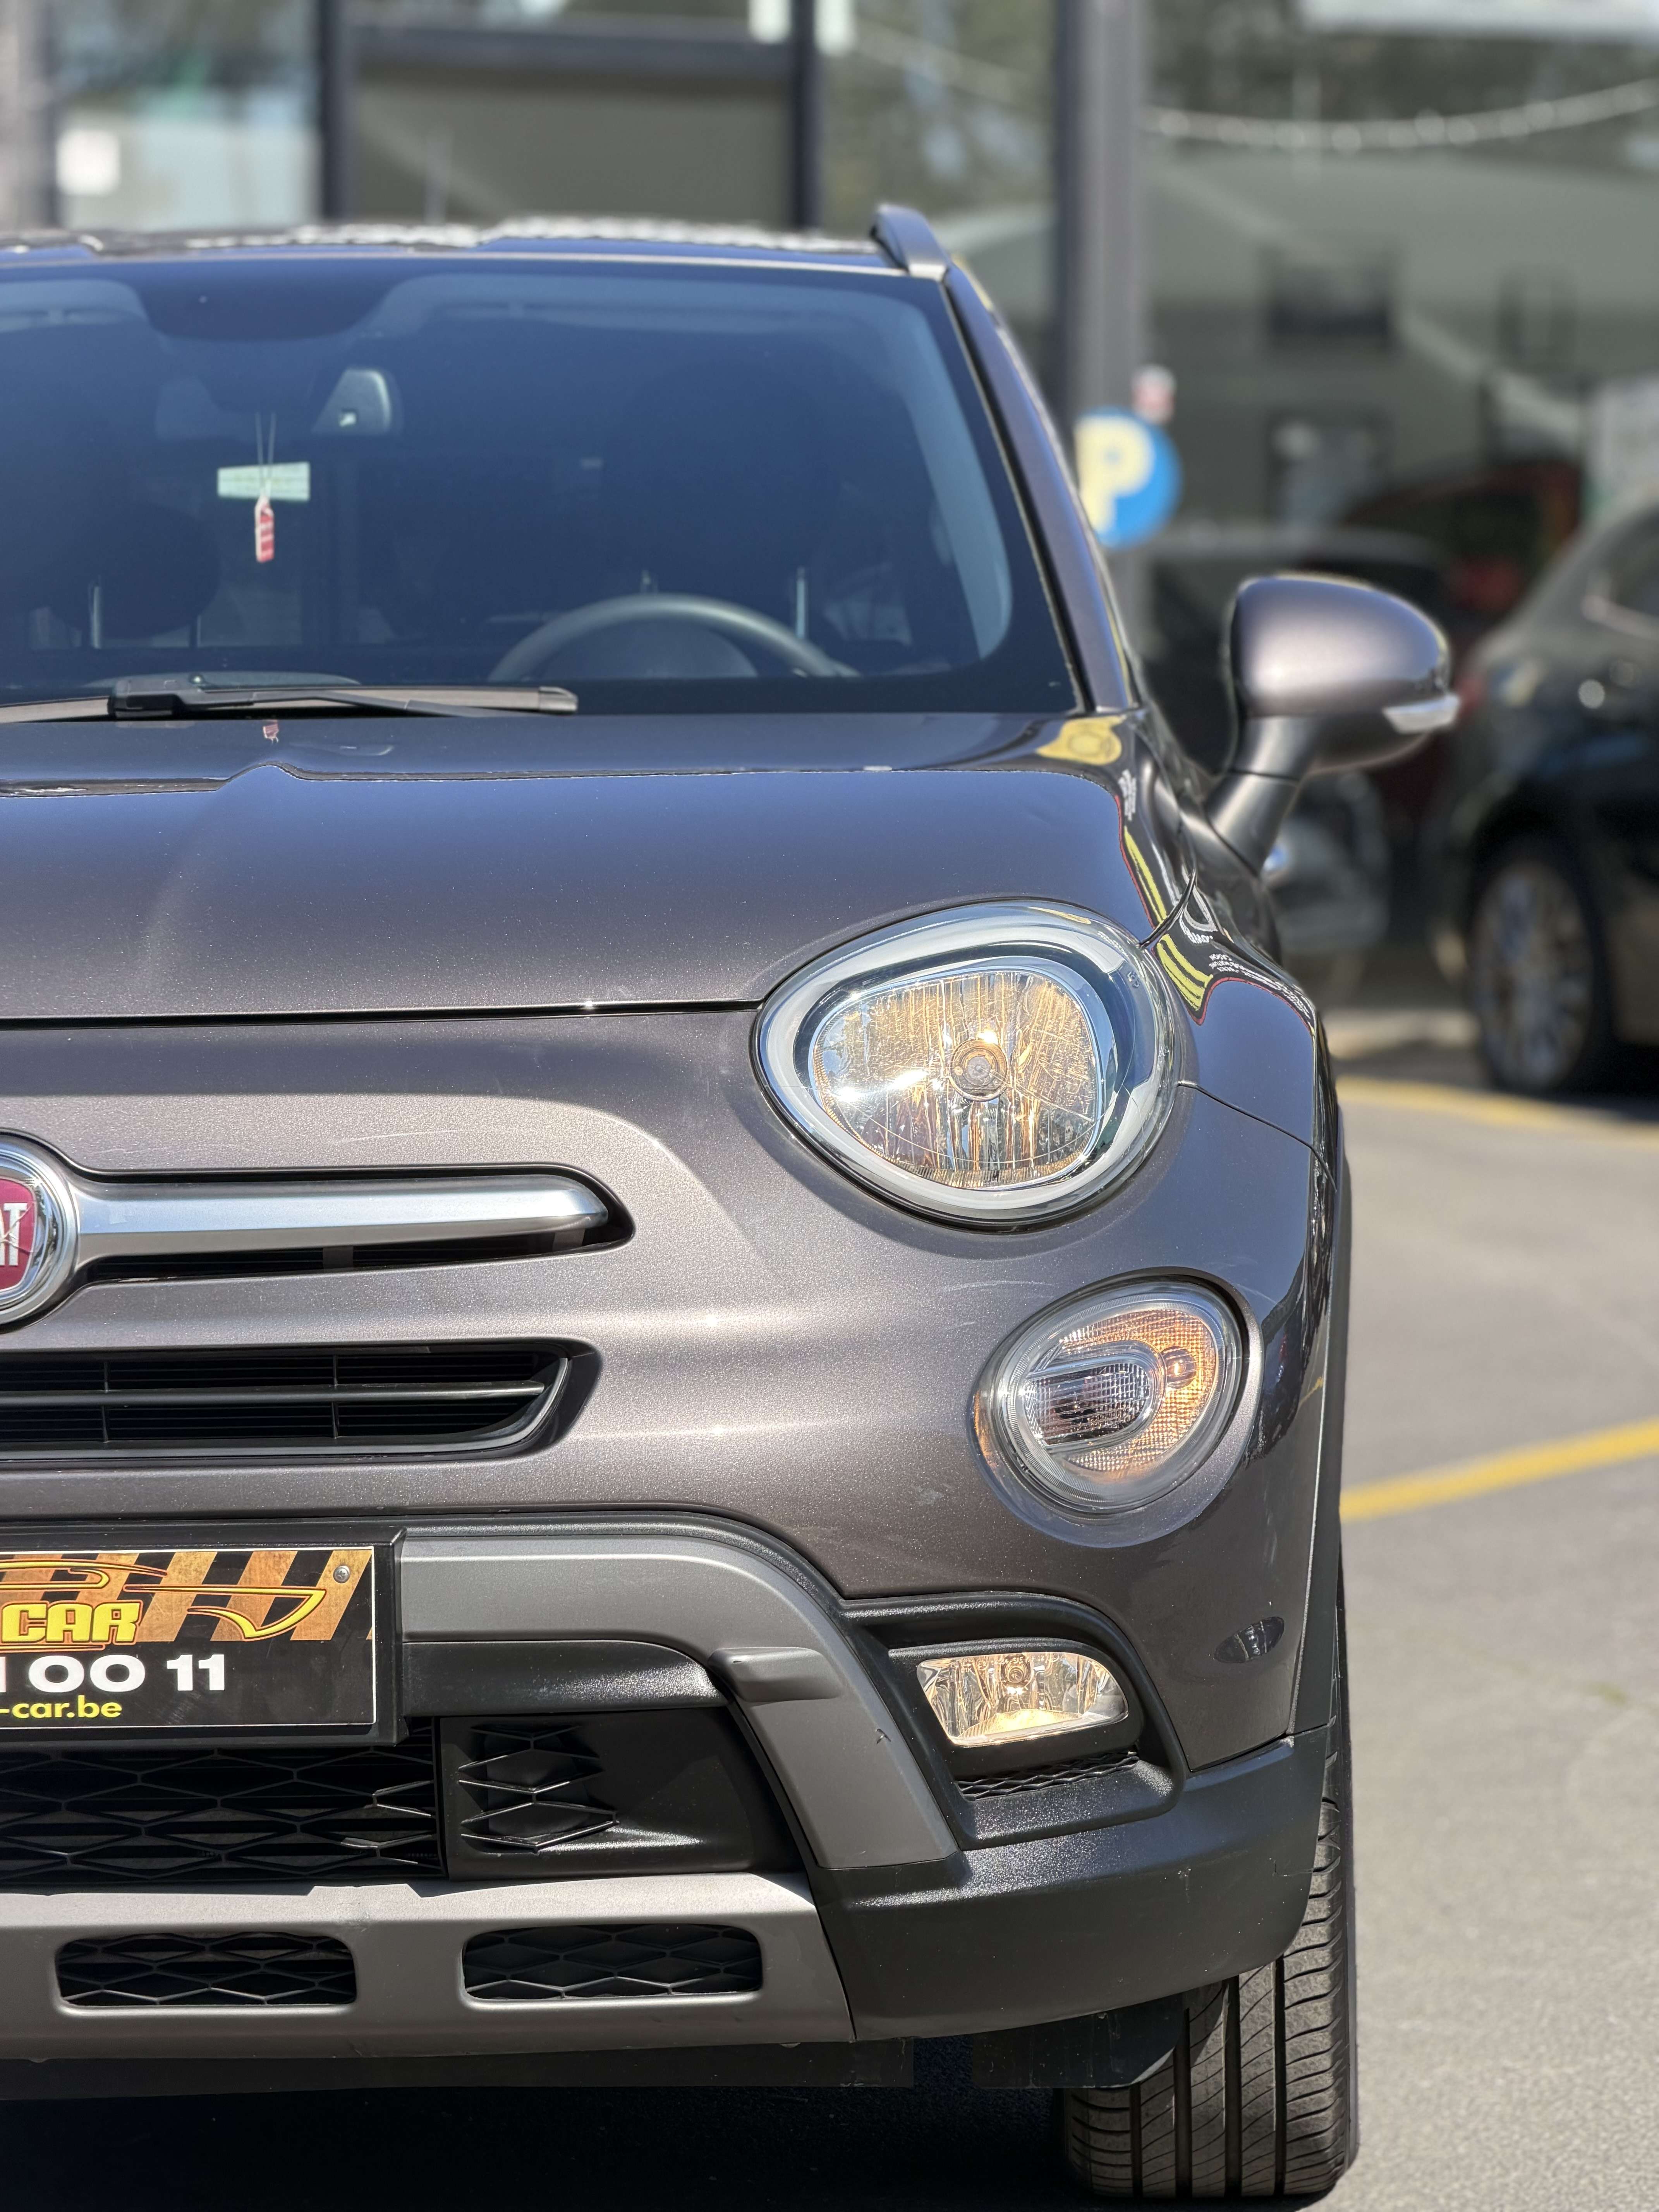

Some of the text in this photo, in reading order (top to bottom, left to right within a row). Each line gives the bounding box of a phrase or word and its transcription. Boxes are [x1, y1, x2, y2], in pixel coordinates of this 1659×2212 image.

[1074, 414, 1156, 532] P
[2, 1602, 141, 1643] CAR
[167, 1654, 225, 1691] 11
